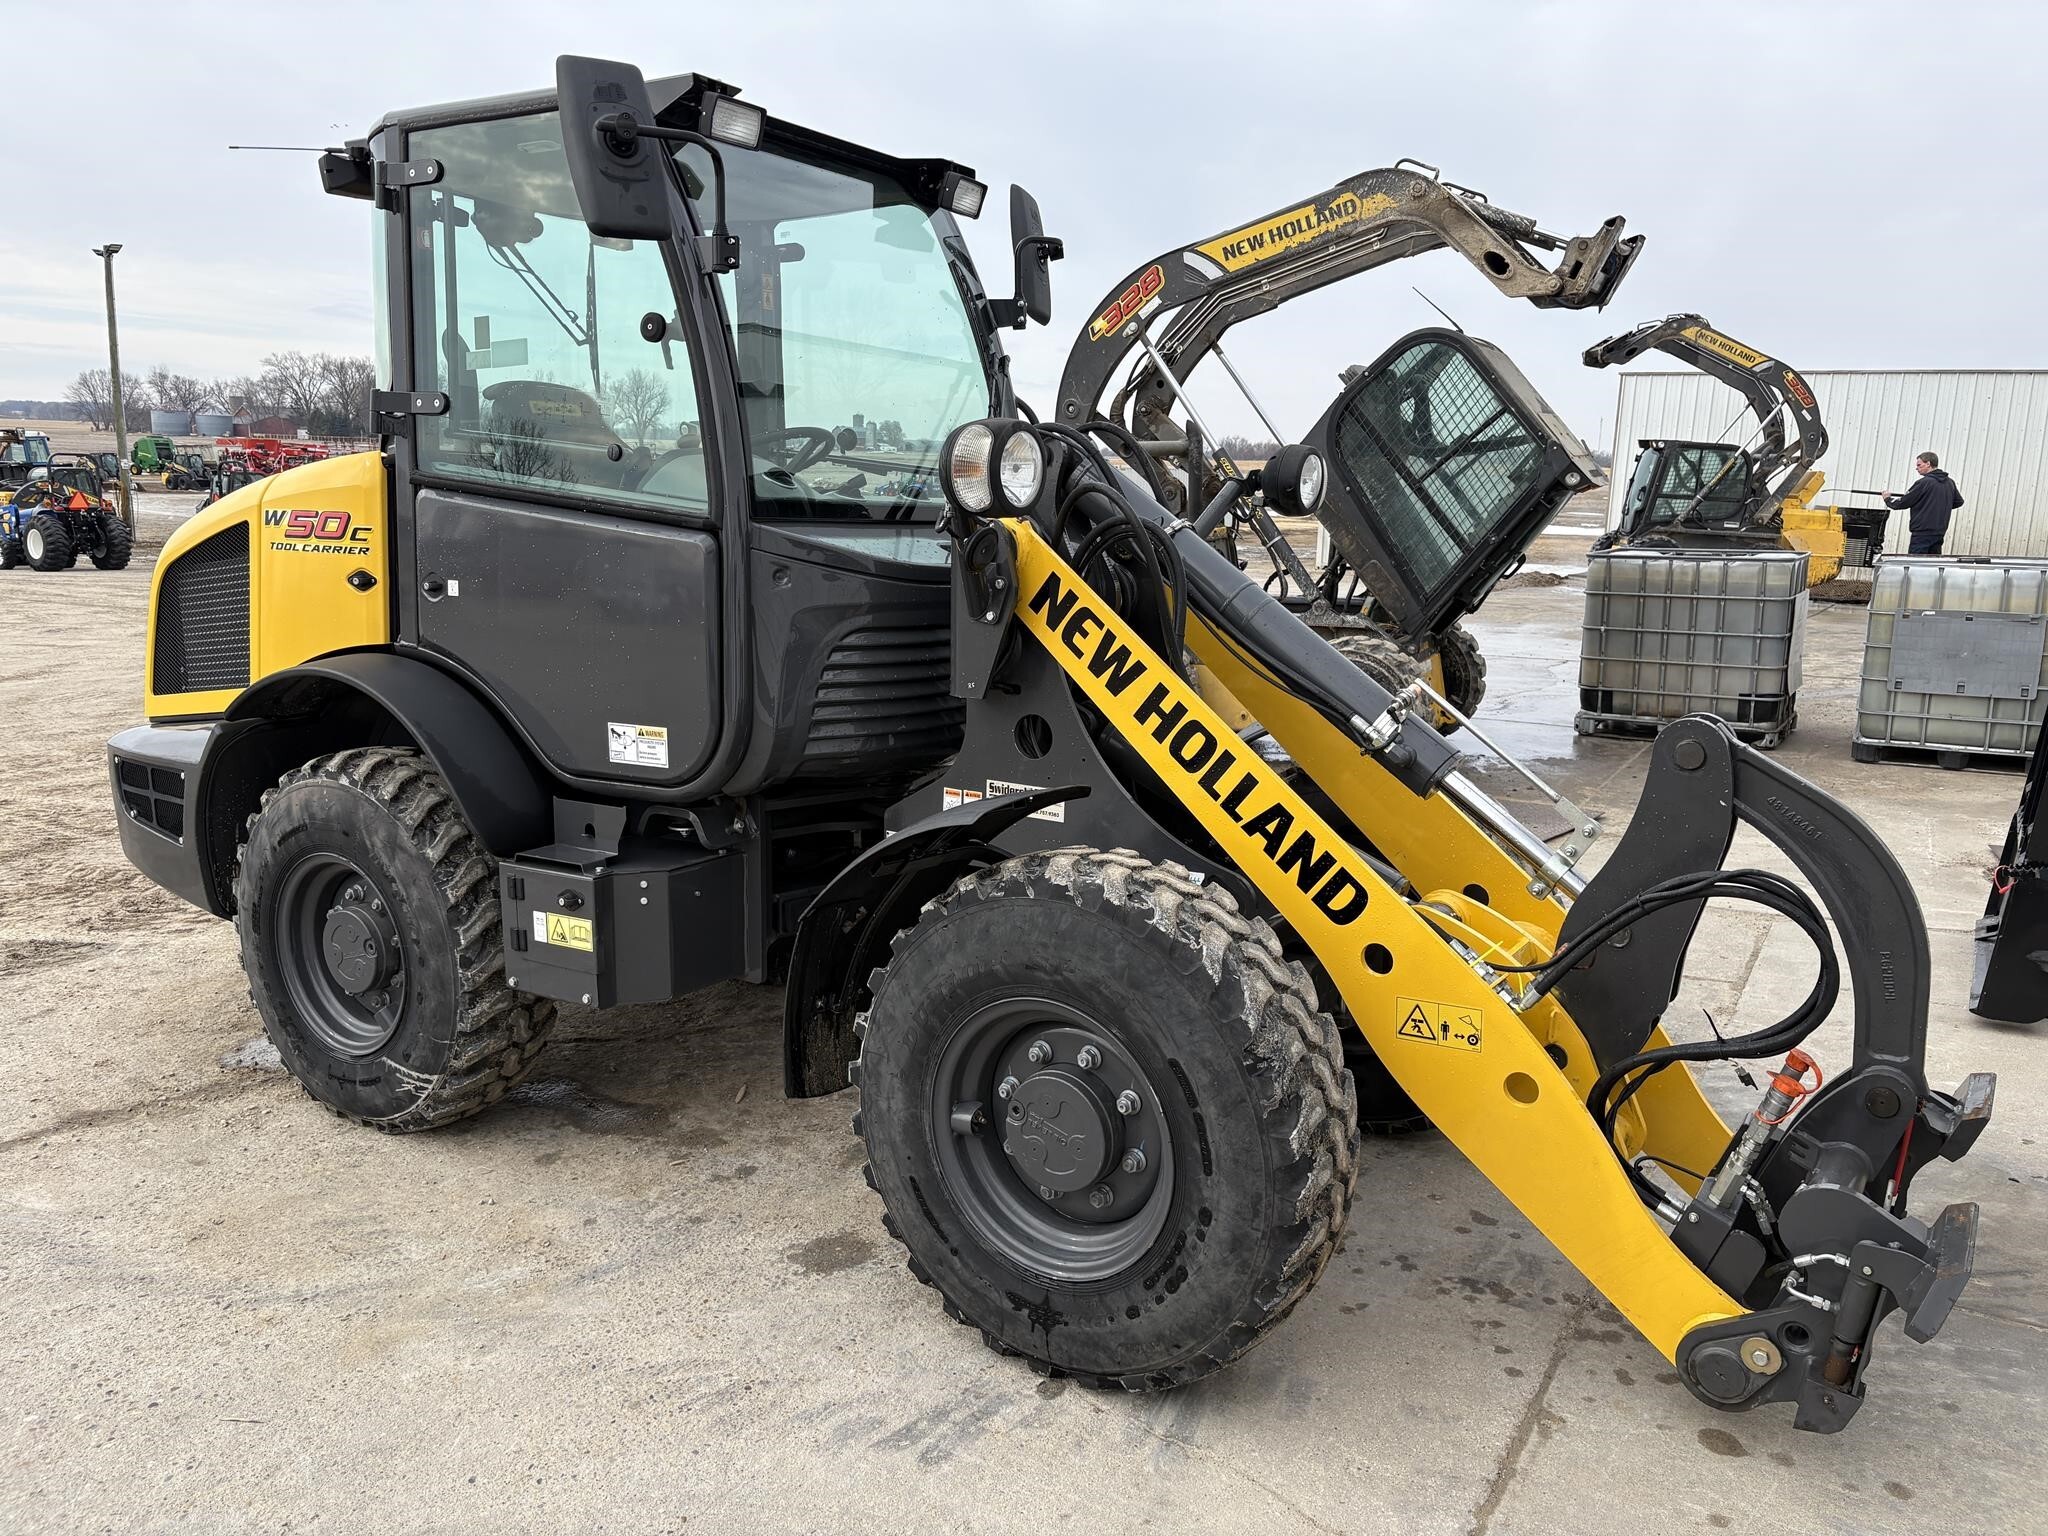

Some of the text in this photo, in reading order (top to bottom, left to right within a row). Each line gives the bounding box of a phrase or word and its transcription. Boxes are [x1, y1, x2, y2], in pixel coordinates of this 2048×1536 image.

[1222, 197, 1358, 261] NEW HOLLAND
[1089, 264, 1164, 340] L328
[1698, 331, 1756, 364] NEW HOLLAND
[1784, 370, 1815, 407] L328
[270, 541, 371, 556] TOOL CARRIER
[1028, 570, 1370, 927] NEW HOLLAND
